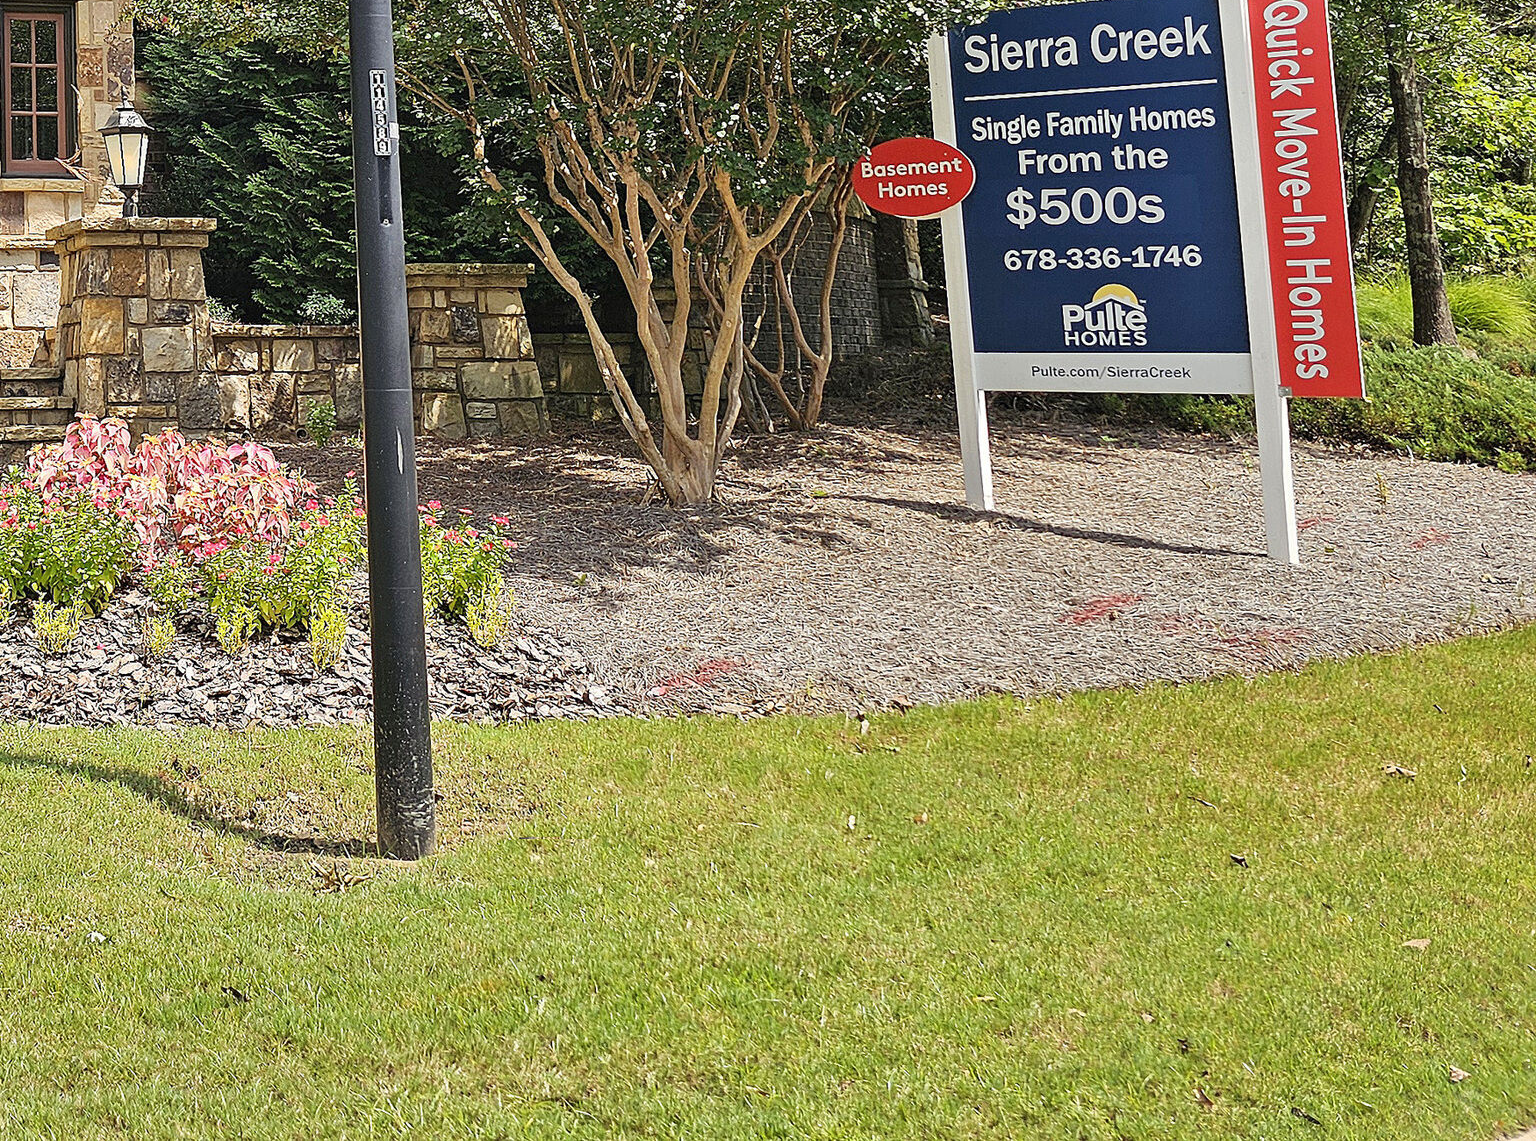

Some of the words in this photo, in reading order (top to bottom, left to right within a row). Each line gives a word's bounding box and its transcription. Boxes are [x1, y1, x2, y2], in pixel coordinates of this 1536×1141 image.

[964, 32, 1078, 74] Sierra
[1090, 16, 1212, 62] Creek
[1263, 0, 1315, 99] Quick
[373, 74, 388, 152] 114589
[971, 113, 1040, 144] Single
[1046, 107, 1123, 139] Family
[1130, 106, 1216, 132] Homes
[861, 157, 962, 178] Basement
[1018, 149, 1102, 175] From
[1112, 143, 1169, 170] the
[878, 180, 948, 199] Homes
[1272, 108, 1328, 247] Move-In
[1006, 186, 1165, 230] $500s
[1003, 245, 1202, 271] 678-336-1746
[1062, 300, 1148, 332] Pulte
[1284, 258, 1333, 380] Homes
[1064, 331, 1147, 347] HOMES
[1031, 364, 1192, 380] Pulte.com/SierraCreek
